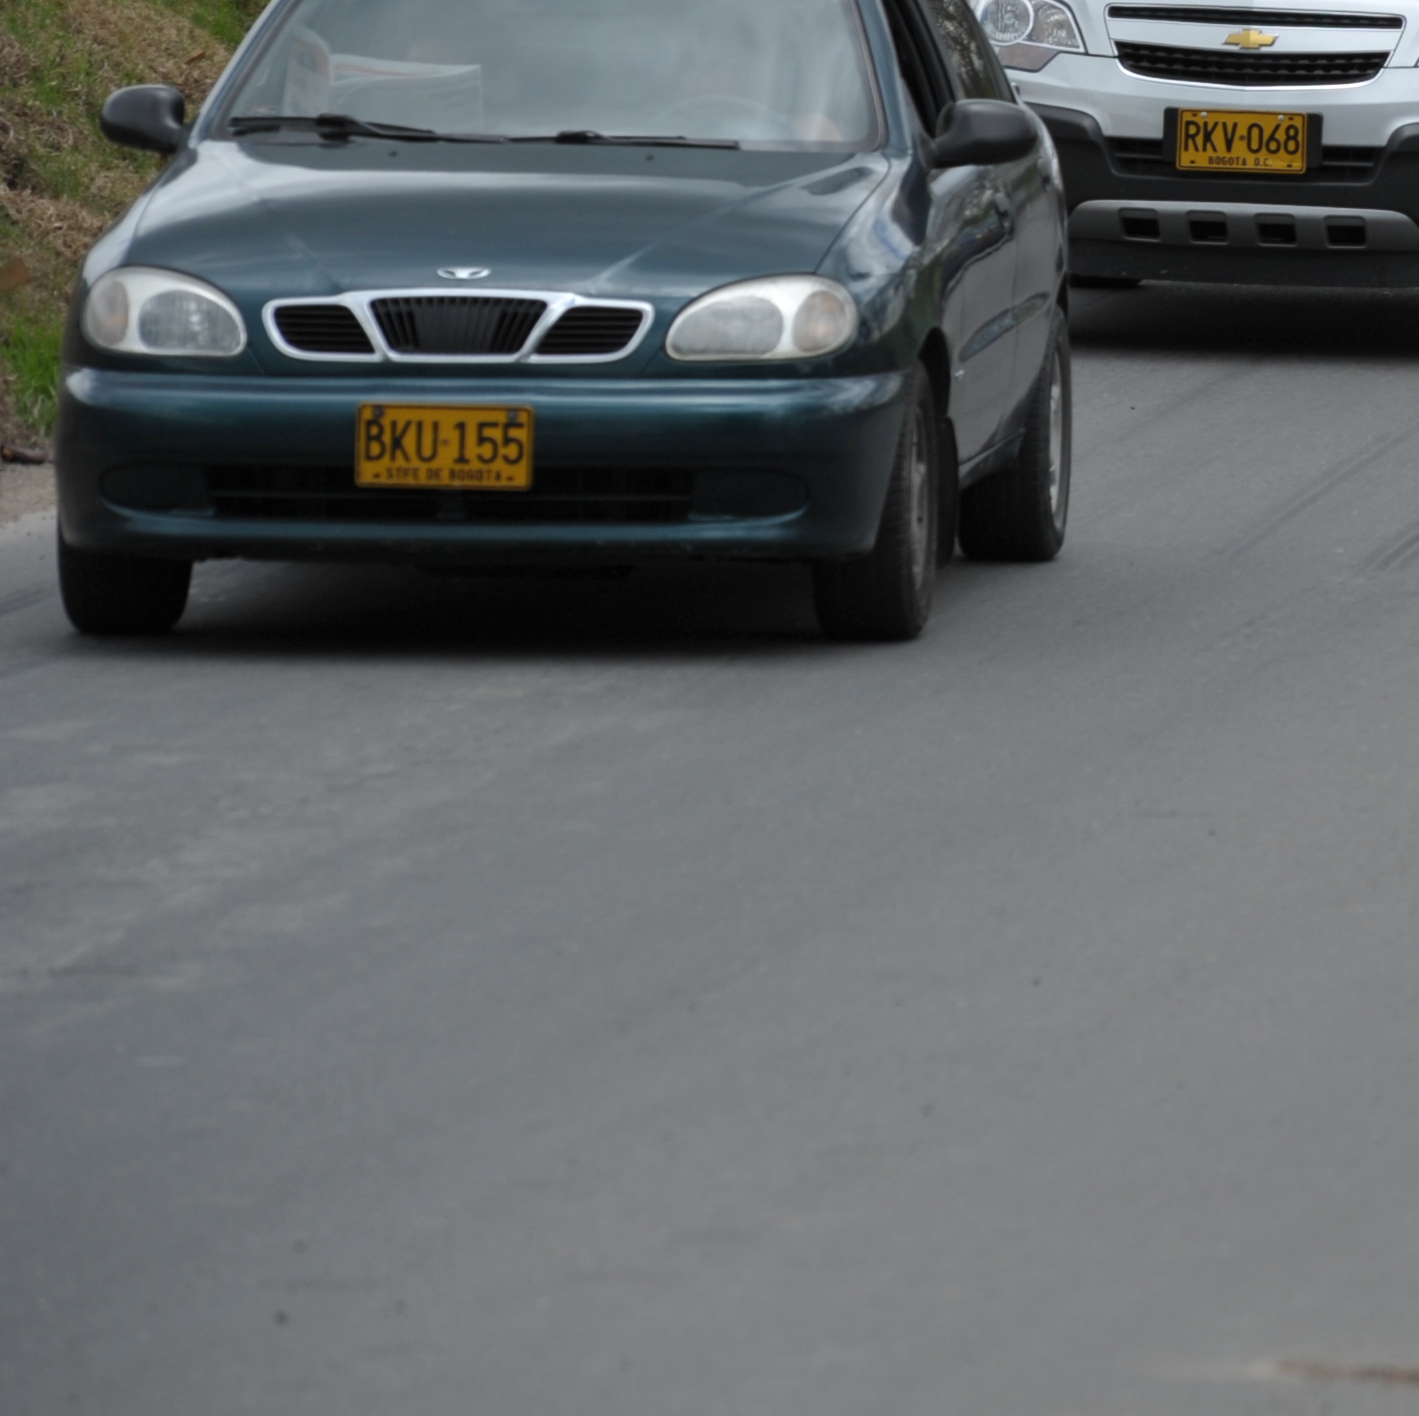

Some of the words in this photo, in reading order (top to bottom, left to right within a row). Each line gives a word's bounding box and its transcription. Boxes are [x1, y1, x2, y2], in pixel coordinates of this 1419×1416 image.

[1208, 155, 1247, 166] BOGOTA
[426, 468, 443, 481] DE
[448, 468, 502, 482] BOGOTA
